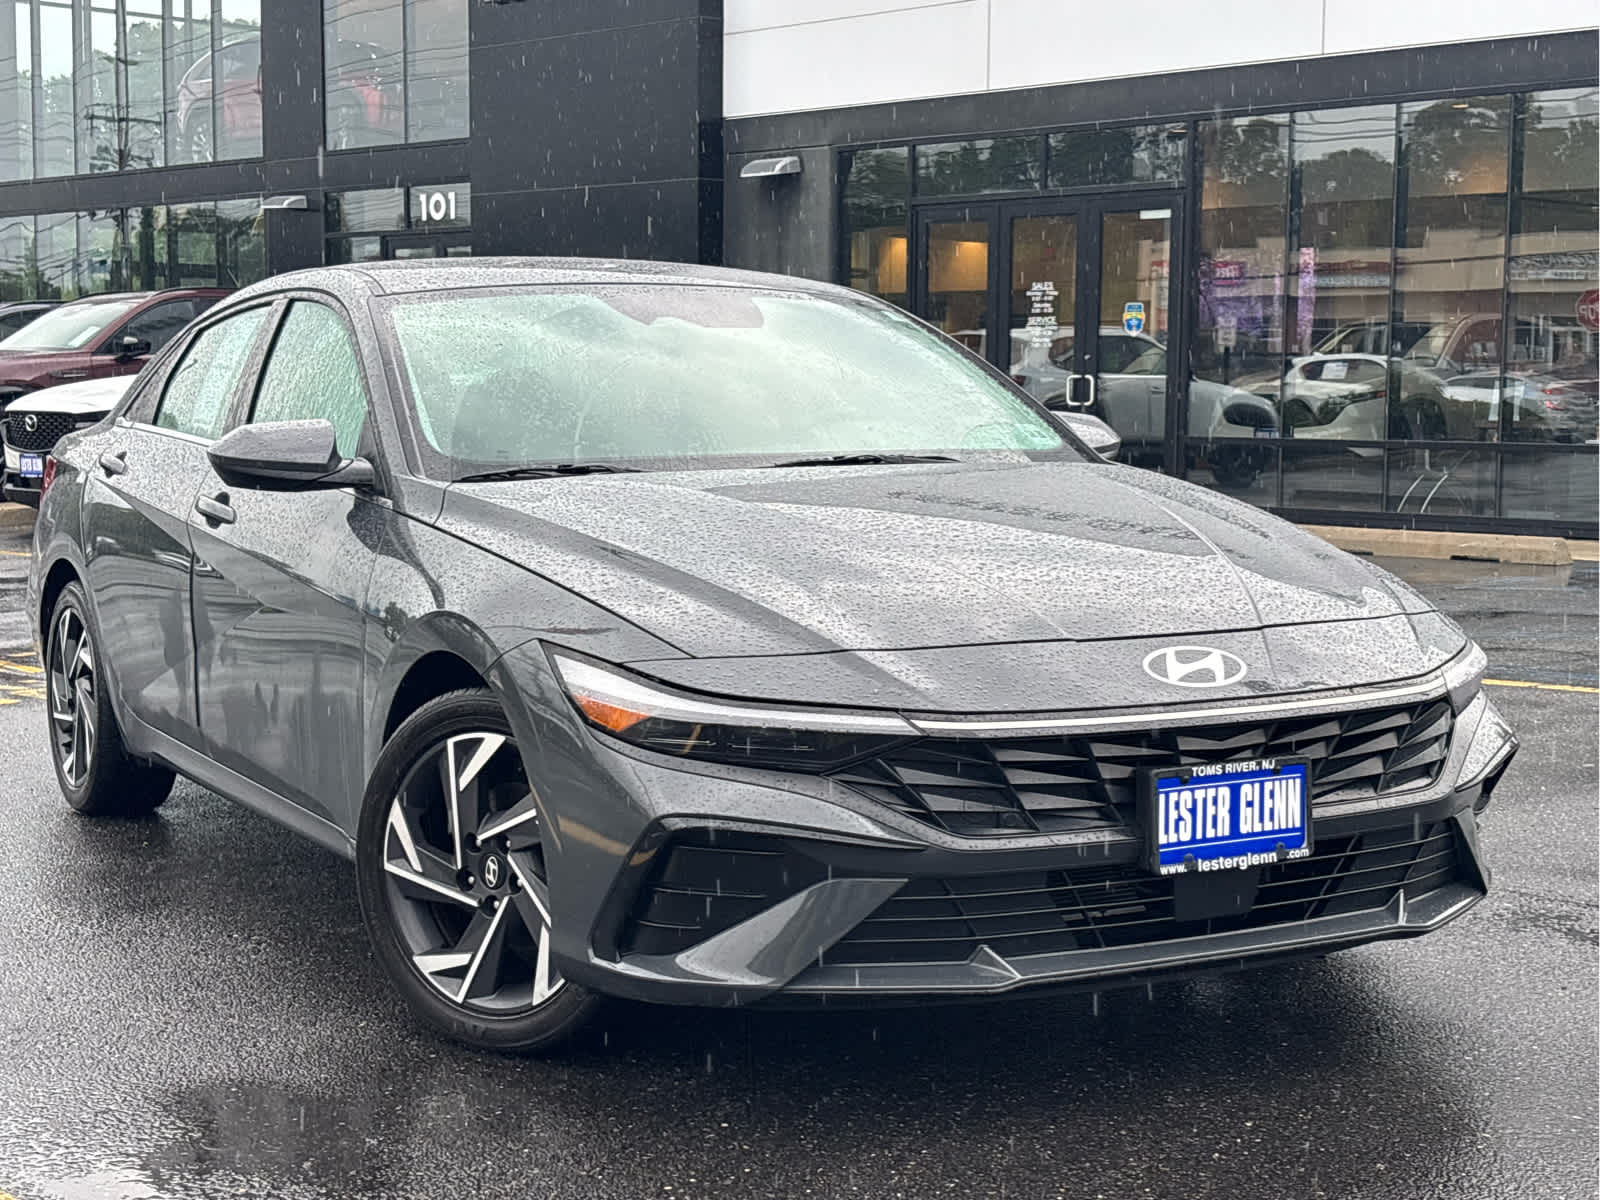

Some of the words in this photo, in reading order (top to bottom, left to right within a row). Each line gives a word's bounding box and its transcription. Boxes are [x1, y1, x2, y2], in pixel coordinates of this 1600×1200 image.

[419, 192, 456, 222] 101
[1192, 766, 1222, 777] TOMS
[1262, 760, 1275, 770] NJ
[1158, 786, 1230, 845] LESTER
[1239, 778, 1301, 834] GLENN
